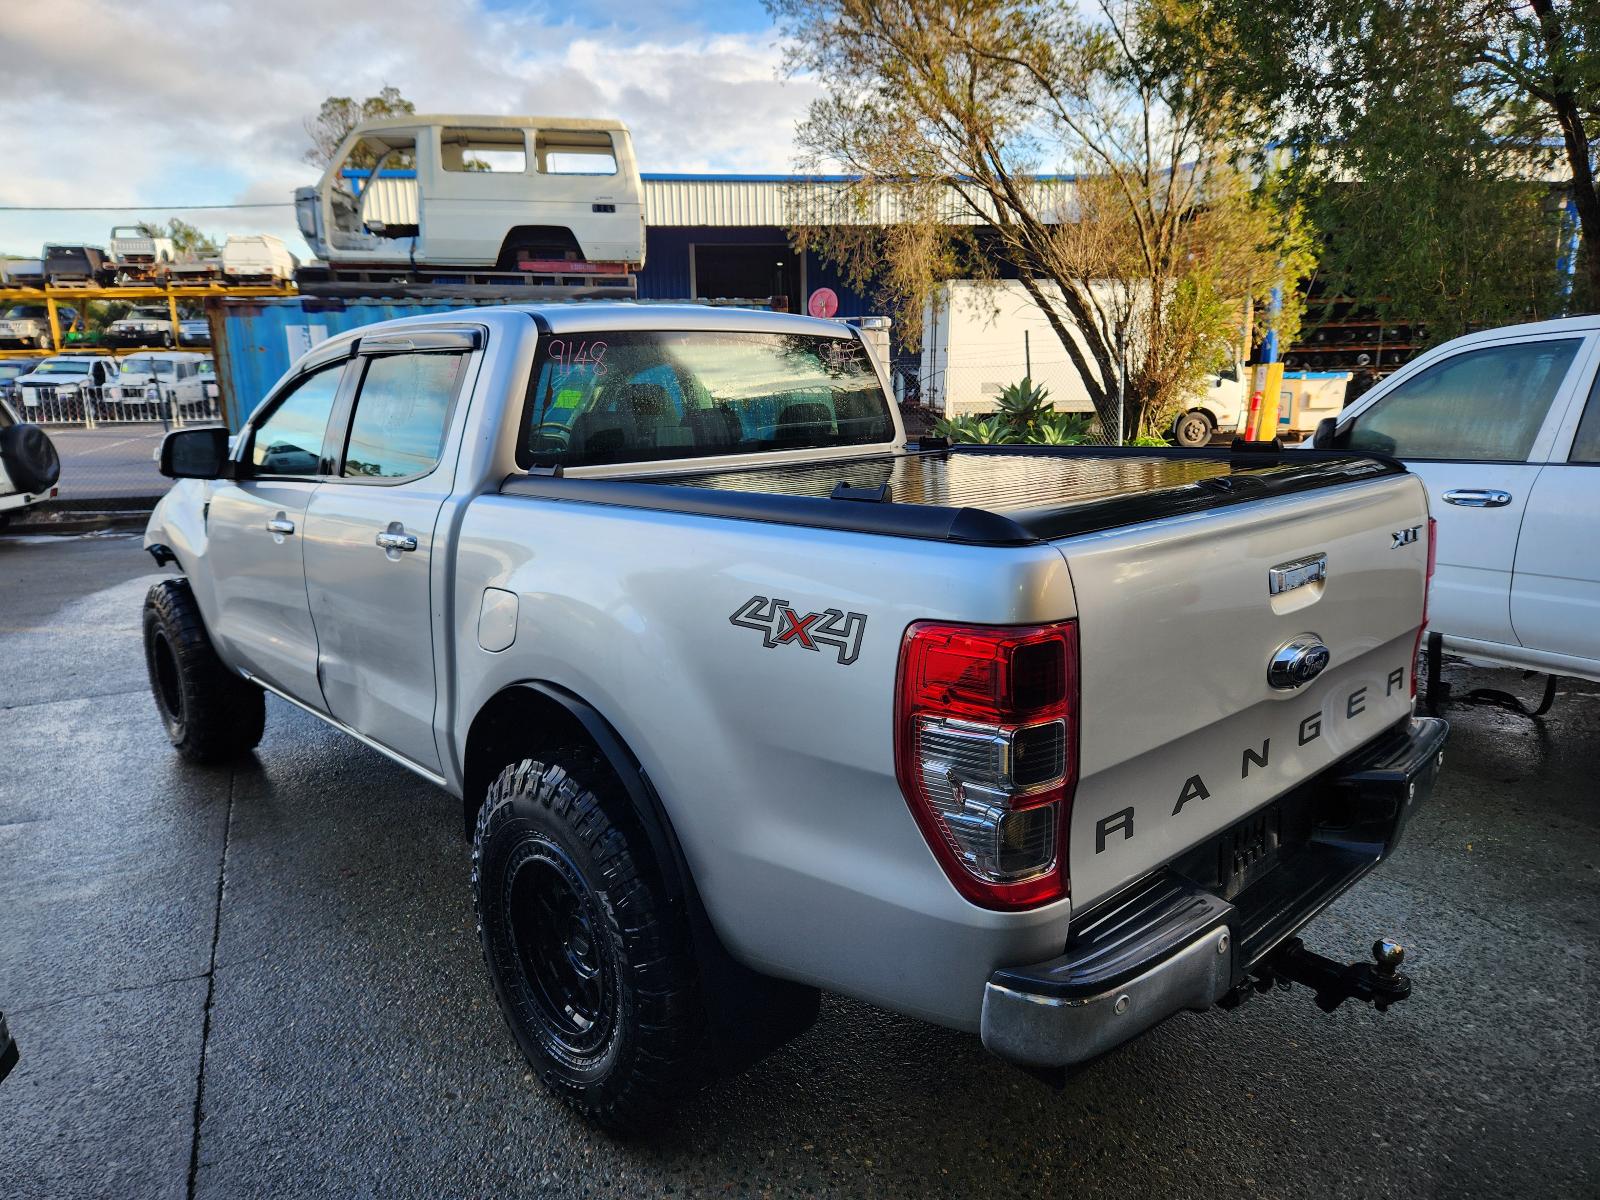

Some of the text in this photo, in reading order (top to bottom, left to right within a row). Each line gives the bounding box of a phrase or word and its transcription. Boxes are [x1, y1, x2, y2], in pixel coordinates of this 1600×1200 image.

[548, 339, 608, 376] 9148
[1391, 524, 1423, 550] XLT
[1302, 651, 1327, 677] Ford
[1095, 666, 1405, 855] RANGER
